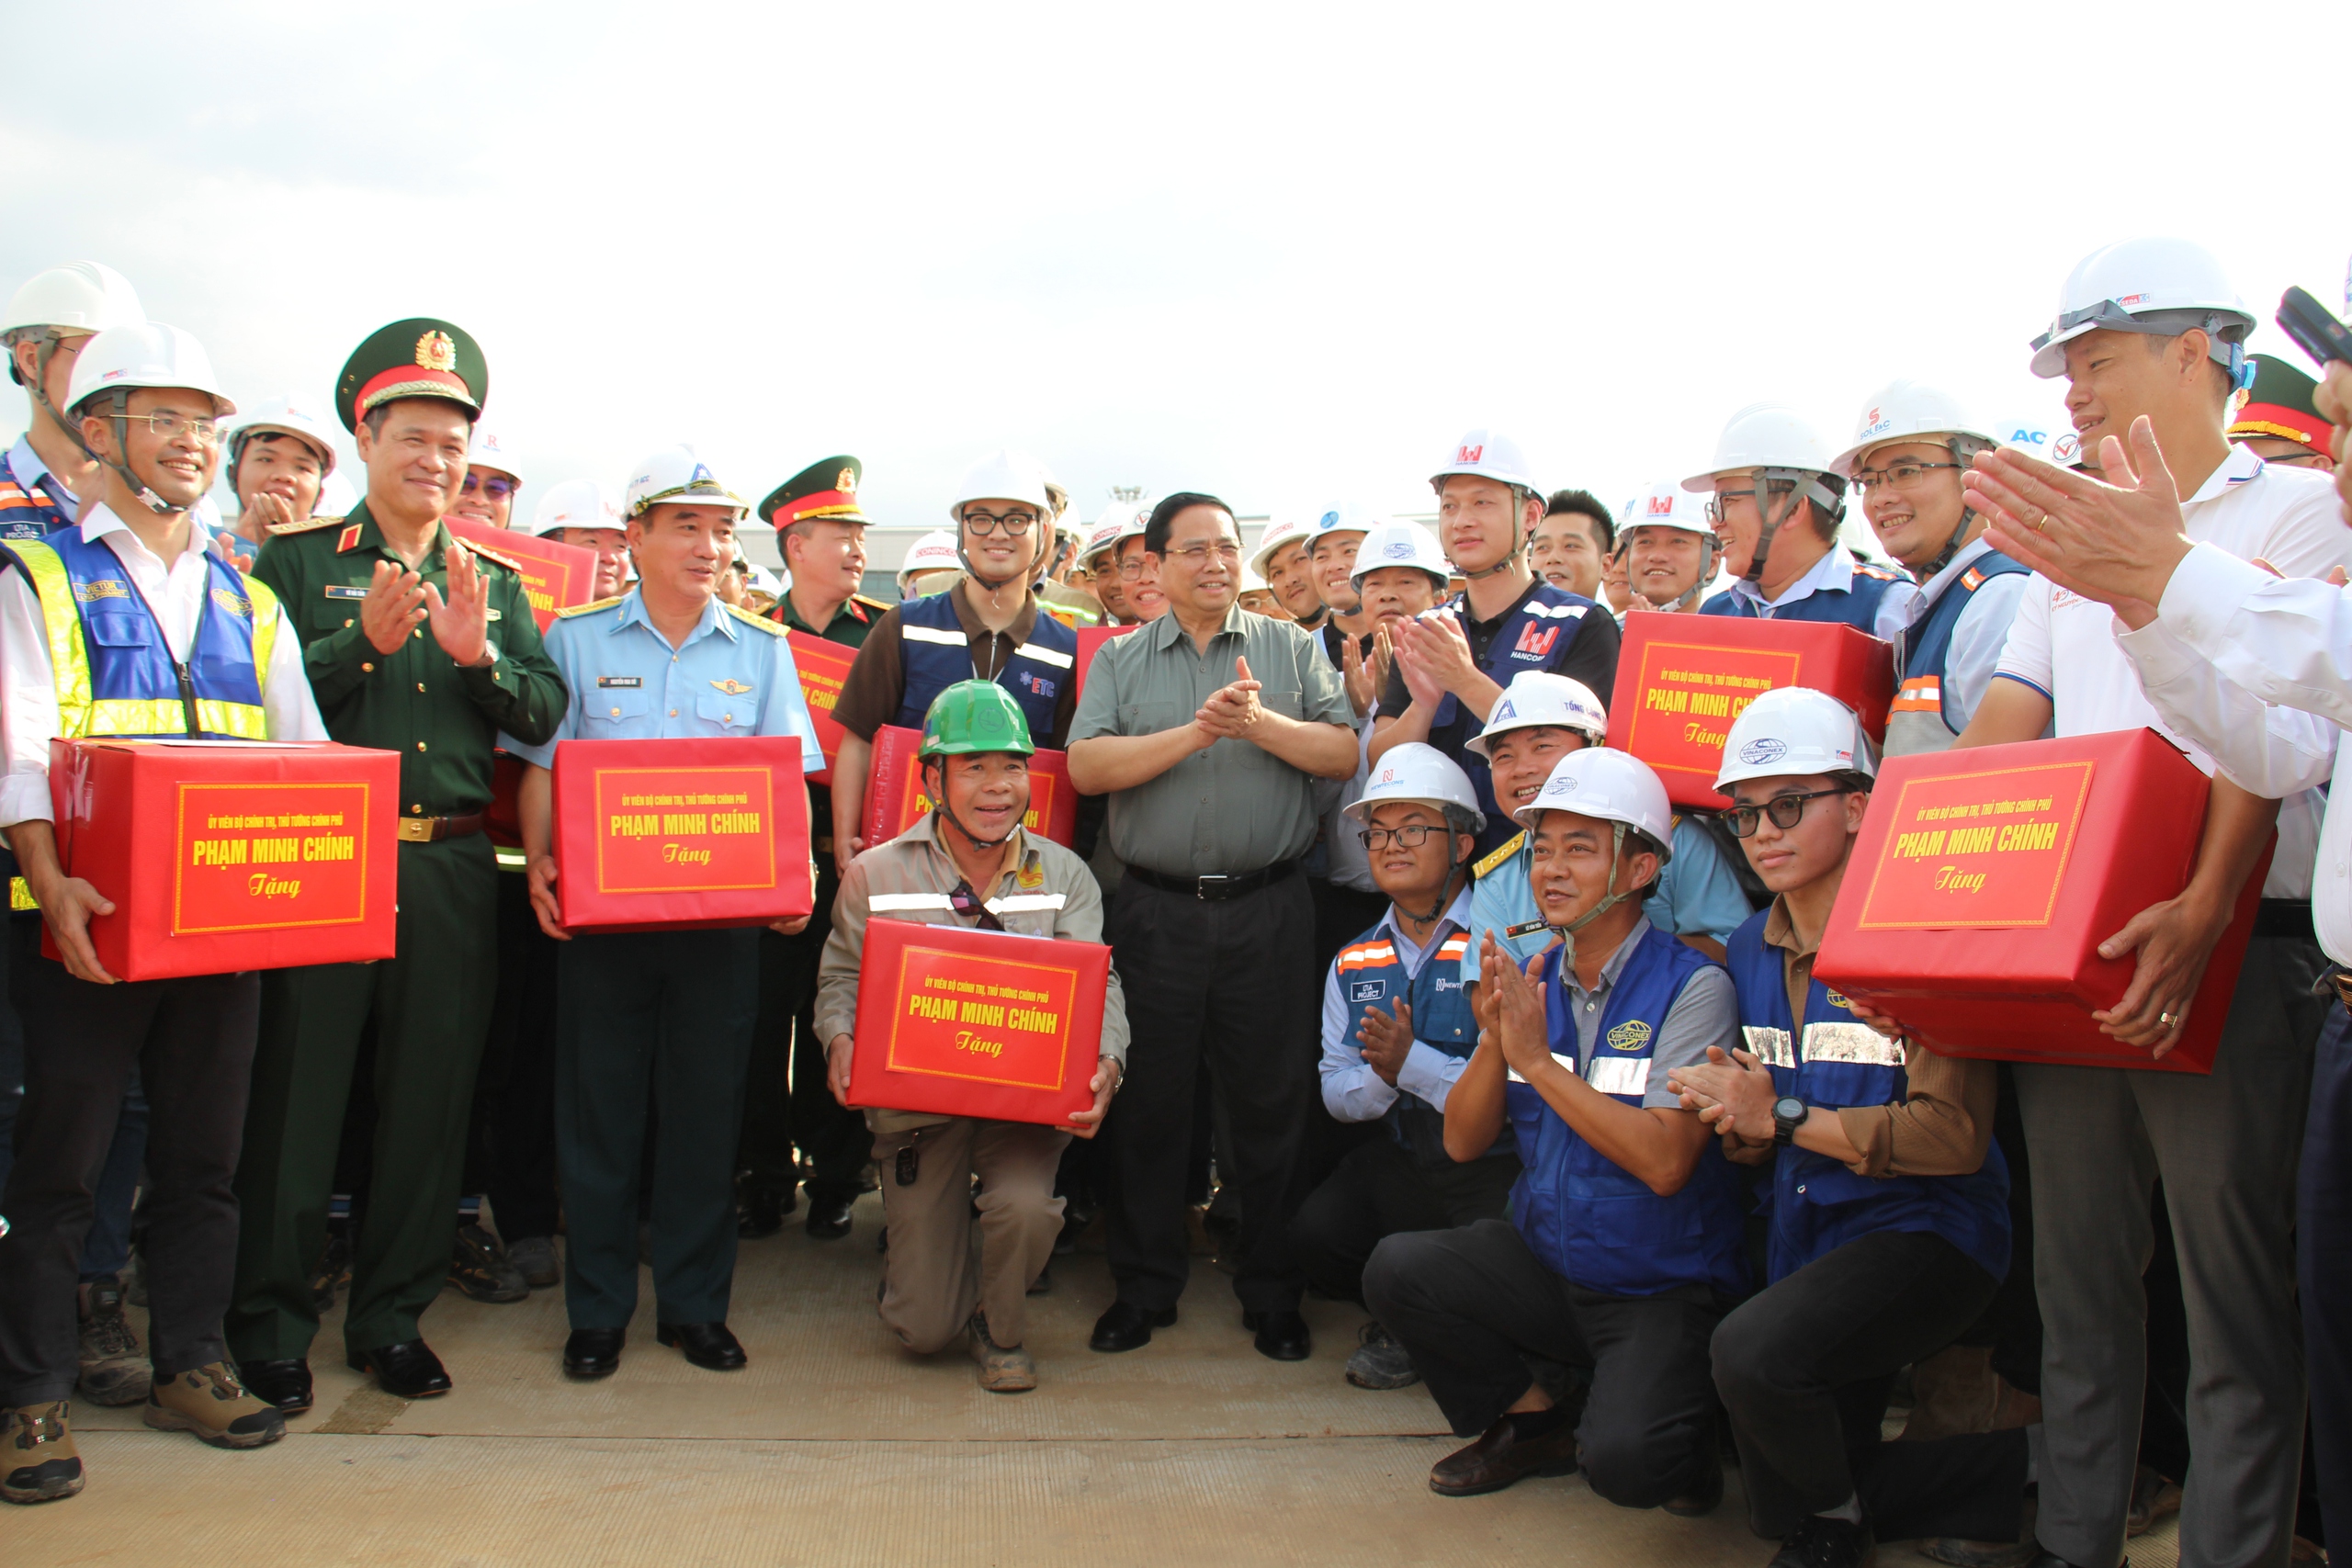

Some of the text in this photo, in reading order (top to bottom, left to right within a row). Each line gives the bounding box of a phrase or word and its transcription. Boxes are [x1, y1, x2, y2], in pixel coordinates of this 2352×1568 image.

[1860, 428, 1873, 440] SOL
[1092, 526, 1122, 542] CONINC
[917, 547, 956, 558] CONINCO
[85, 581, 117, 593] VIETUR
[526, 588, 554, 612] ÍNH
[1032, 677, 1055, 697] ETC
[809, 689, 839, 710] CHÍN
[1564, 700, 1585, 714] TỔNG
[1645, 688, 1689, 716] PHẠM
[1690, 693, 1730, 717] MINH
[1684, 722, 1727, 750] Tặng
[1742, 747, 1783, 756] VINACONEX
[1371, 780, 1405, 791] NEWTECONS
[1917, 807, 1927, 821] ỦY
[1926, 807, 1940, 821] VIÊN
[1939, 805, 1950, 822] BỘ
[1949, 804, 1969, 818] CHÍNH
[1981, 799, 1995, 816] THỦ
[2016, 797, 2037, 813] CHÍNH
[2036, 795, 2052, 811] PHỦ
[610, 808, 761, 840] PHẠM MINH CHÍNH
[193, 831, 354, 870] PHẠM MINH CHÍNH
[1893, 818, 2059, 863] PHẠM MINH CHÍNH
[662, 843, 712, 866] Tặng
[248, 873, 301, 899] Tặng
[1934, 865, 1986, 894] Tặng
[924, 975, 933, 987] ỦY
[933, 977, 947, 989] VIÊN
[948, 979, 956, 993] BỘ
[956, 980, 975, 993] CHÍNH
[988, 984, 999, 997] THỦ
[1019, 988, 1036, 1002] CHÍNH
[1036, 990, 1049, 1003] PHỦ
[1357, 990, 1379, 999] PROJECT
[909, 995, 1057, 1034] PHẠM MINH CHÍNH
[955, 1031, 1003, 1058] Tặng
